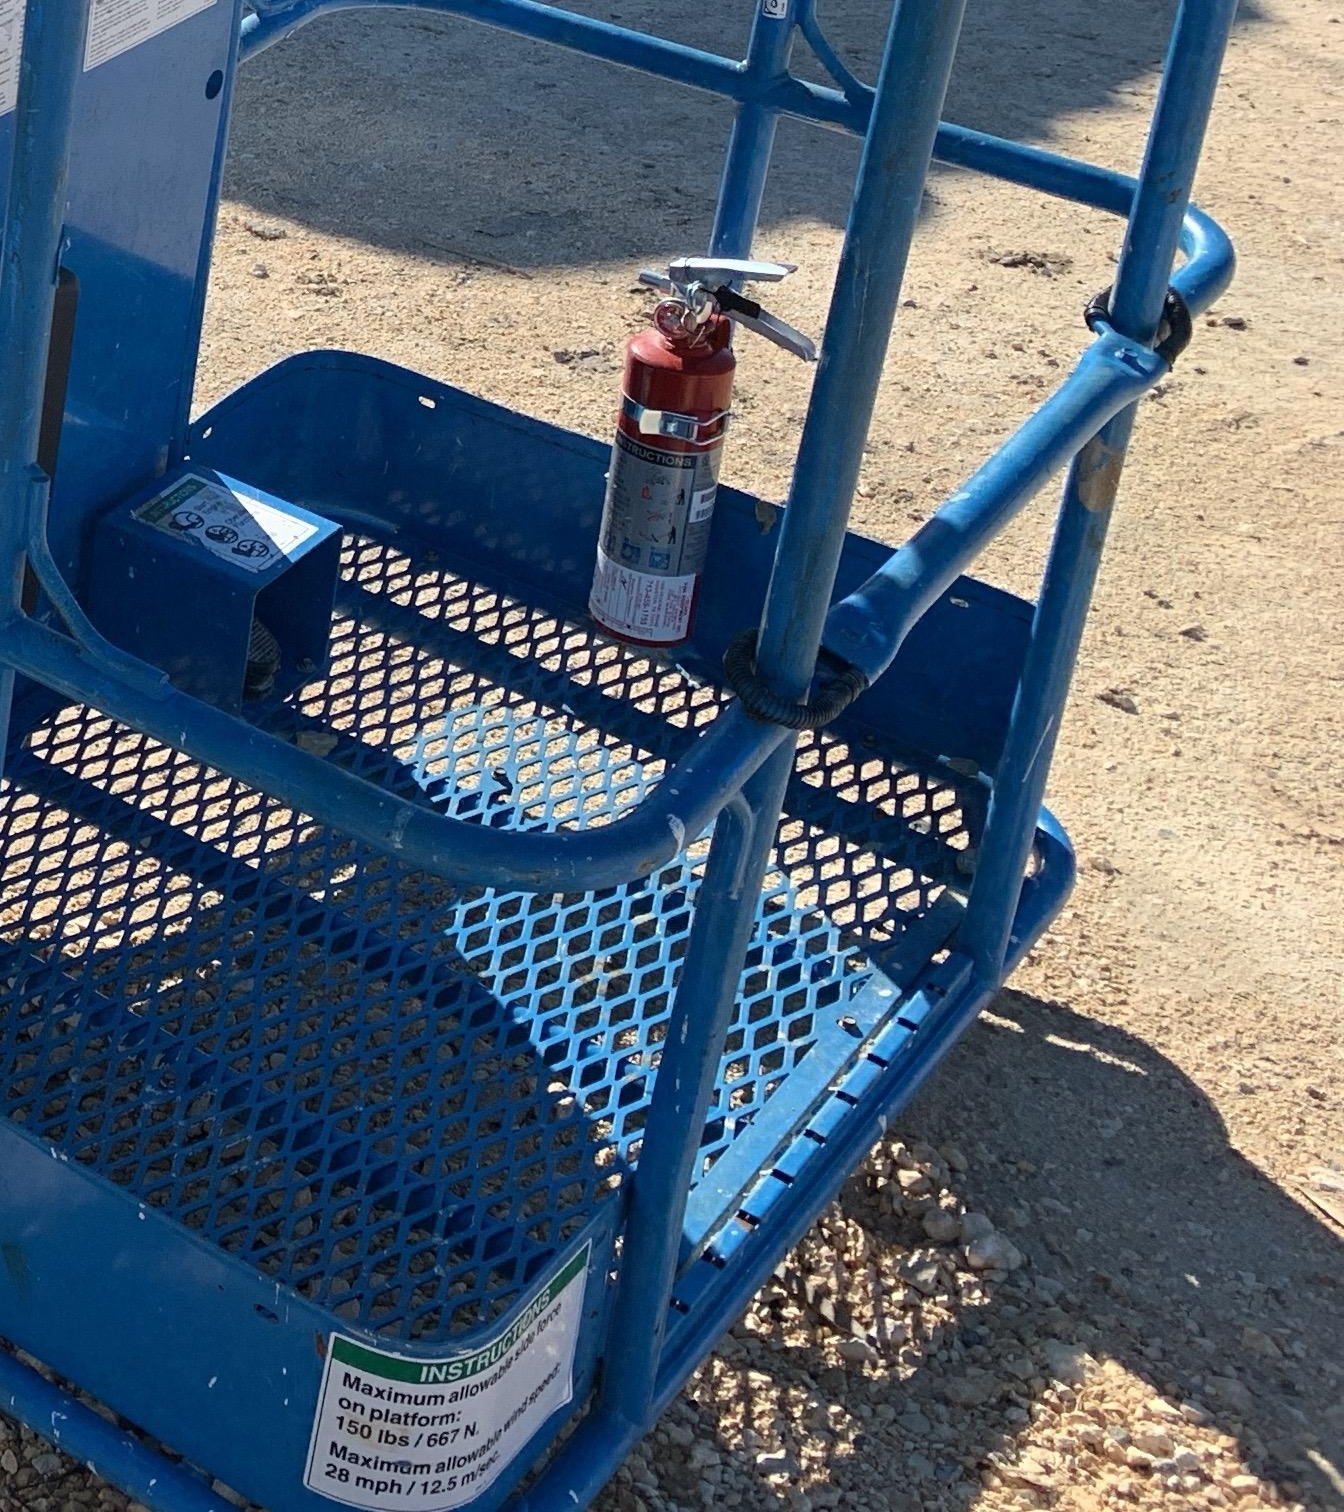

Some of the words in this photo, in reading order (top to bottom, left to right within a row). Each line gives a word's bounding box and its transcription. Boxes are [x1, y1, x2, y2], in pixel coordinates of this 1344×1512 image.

[342, 1372, 445, 1407] Maximum
[448, 1356, 514, 1404] allowable
[515, 1331, 536, 1361] side
[536, 1302, 562, 1336] force
[420, 1288, 551, 1383] INSTRUCTIONS
[329, 1441, 432, 1476] Maximum
[435, 1429, 503, 1474] allowable
[504, 1396, 528, 1432] wind
[335, 1415, 373, 1441] 150
[377, 1428, 410, 1448] lbs
[414, 1429, 423, 1448] /
[426, 1429, 460, 1449] 667
[338, 1396, 365, 1416] on
[369, 1406, 462, 1428] platform:
[324, 1462, 350, 1484] 28
[355, 1474, 402, 1497] mph
[406, 1478, 416, 1496] /
[421, 1475, 458, 1496] 12.5
